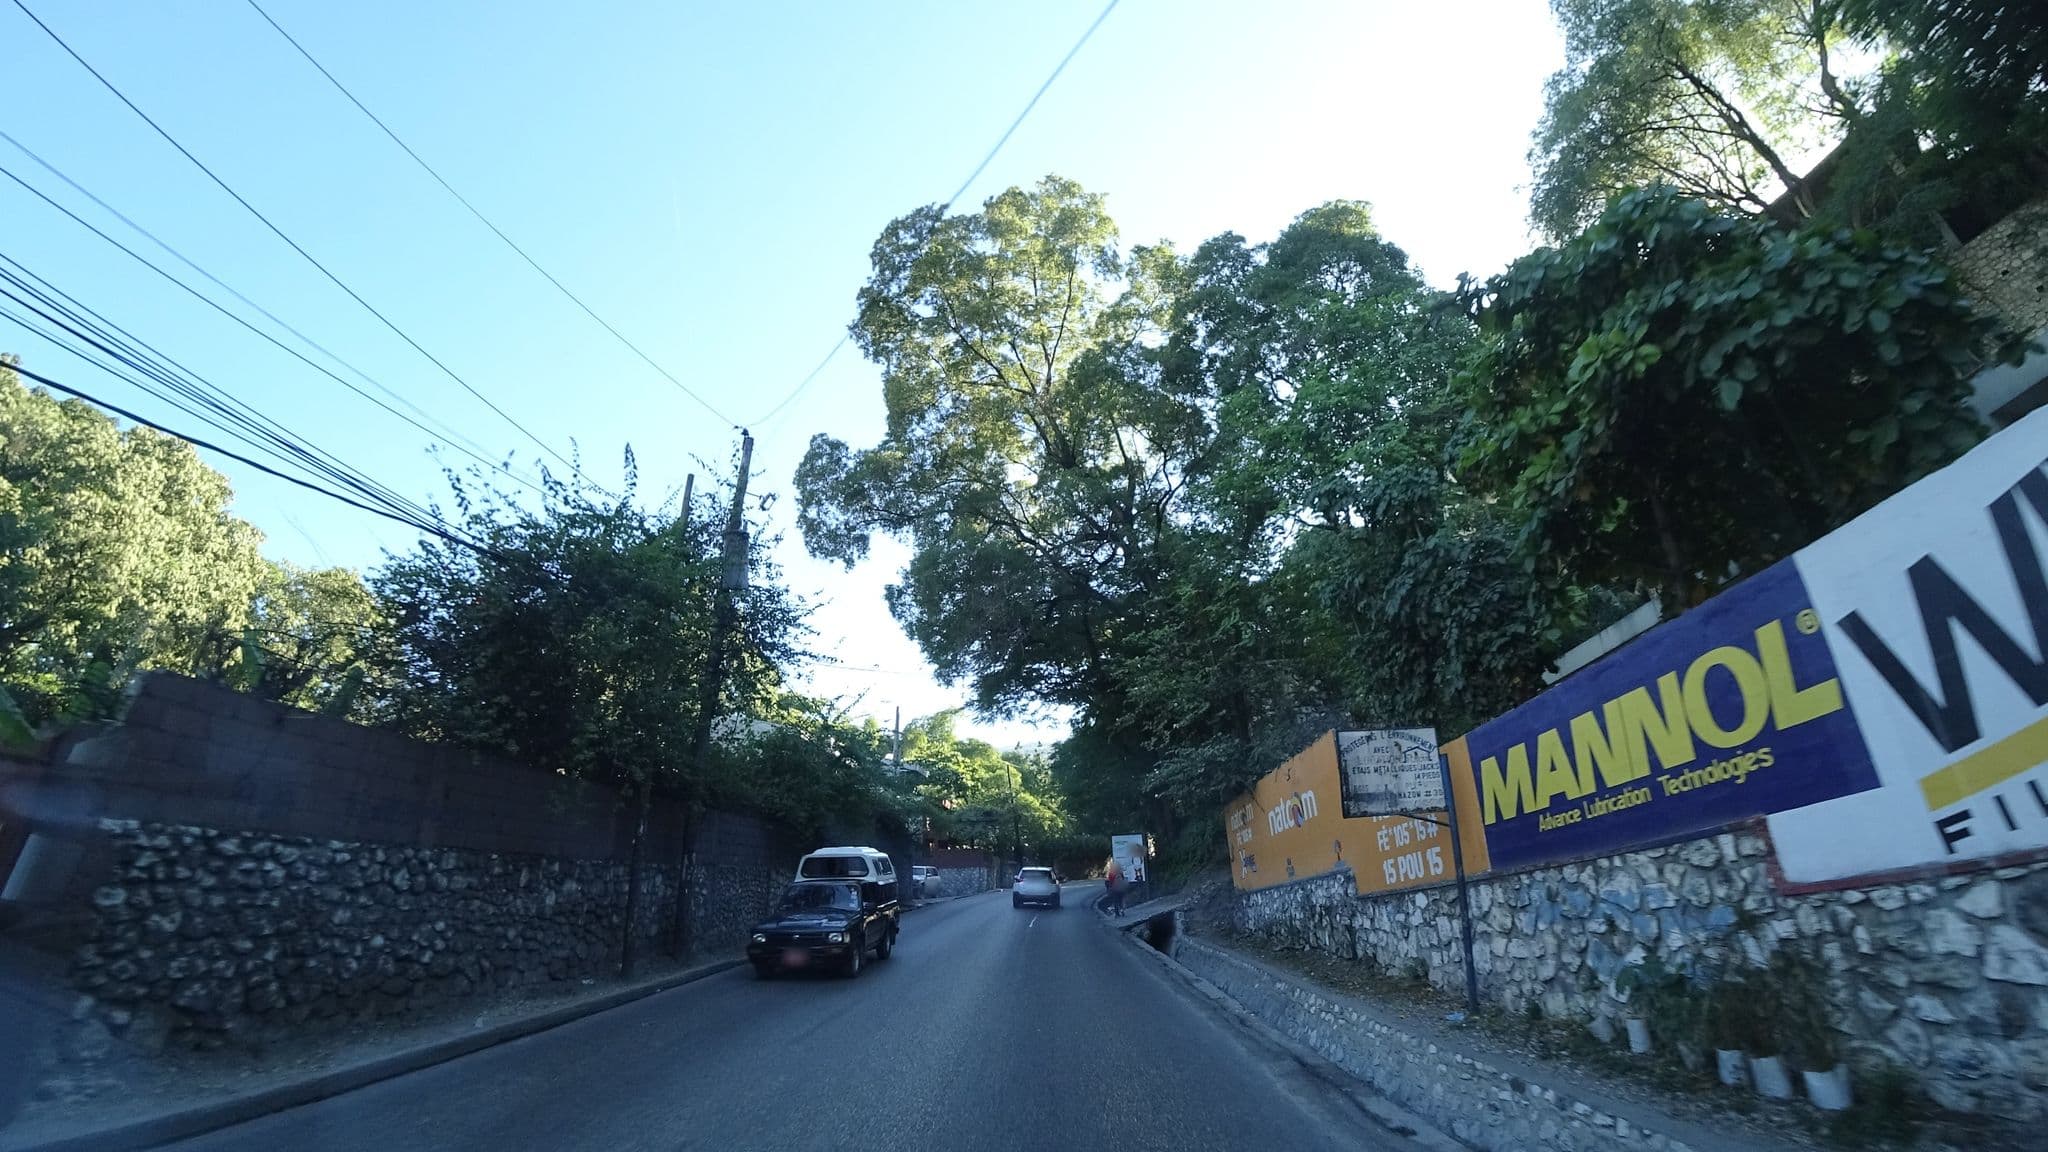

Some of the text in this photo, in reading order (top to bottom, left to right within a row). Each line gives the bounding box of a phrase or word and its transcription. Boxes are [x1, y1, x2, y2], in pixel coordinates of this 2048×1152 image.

[1480, 618, 1844, 826] MANNOL
[1268, 789, 1318, 837] natcom
[1539, 747, 1775, 833] Advance Lubrication Technologies
[1383, 846, 1444, 885] 15 POU 15
